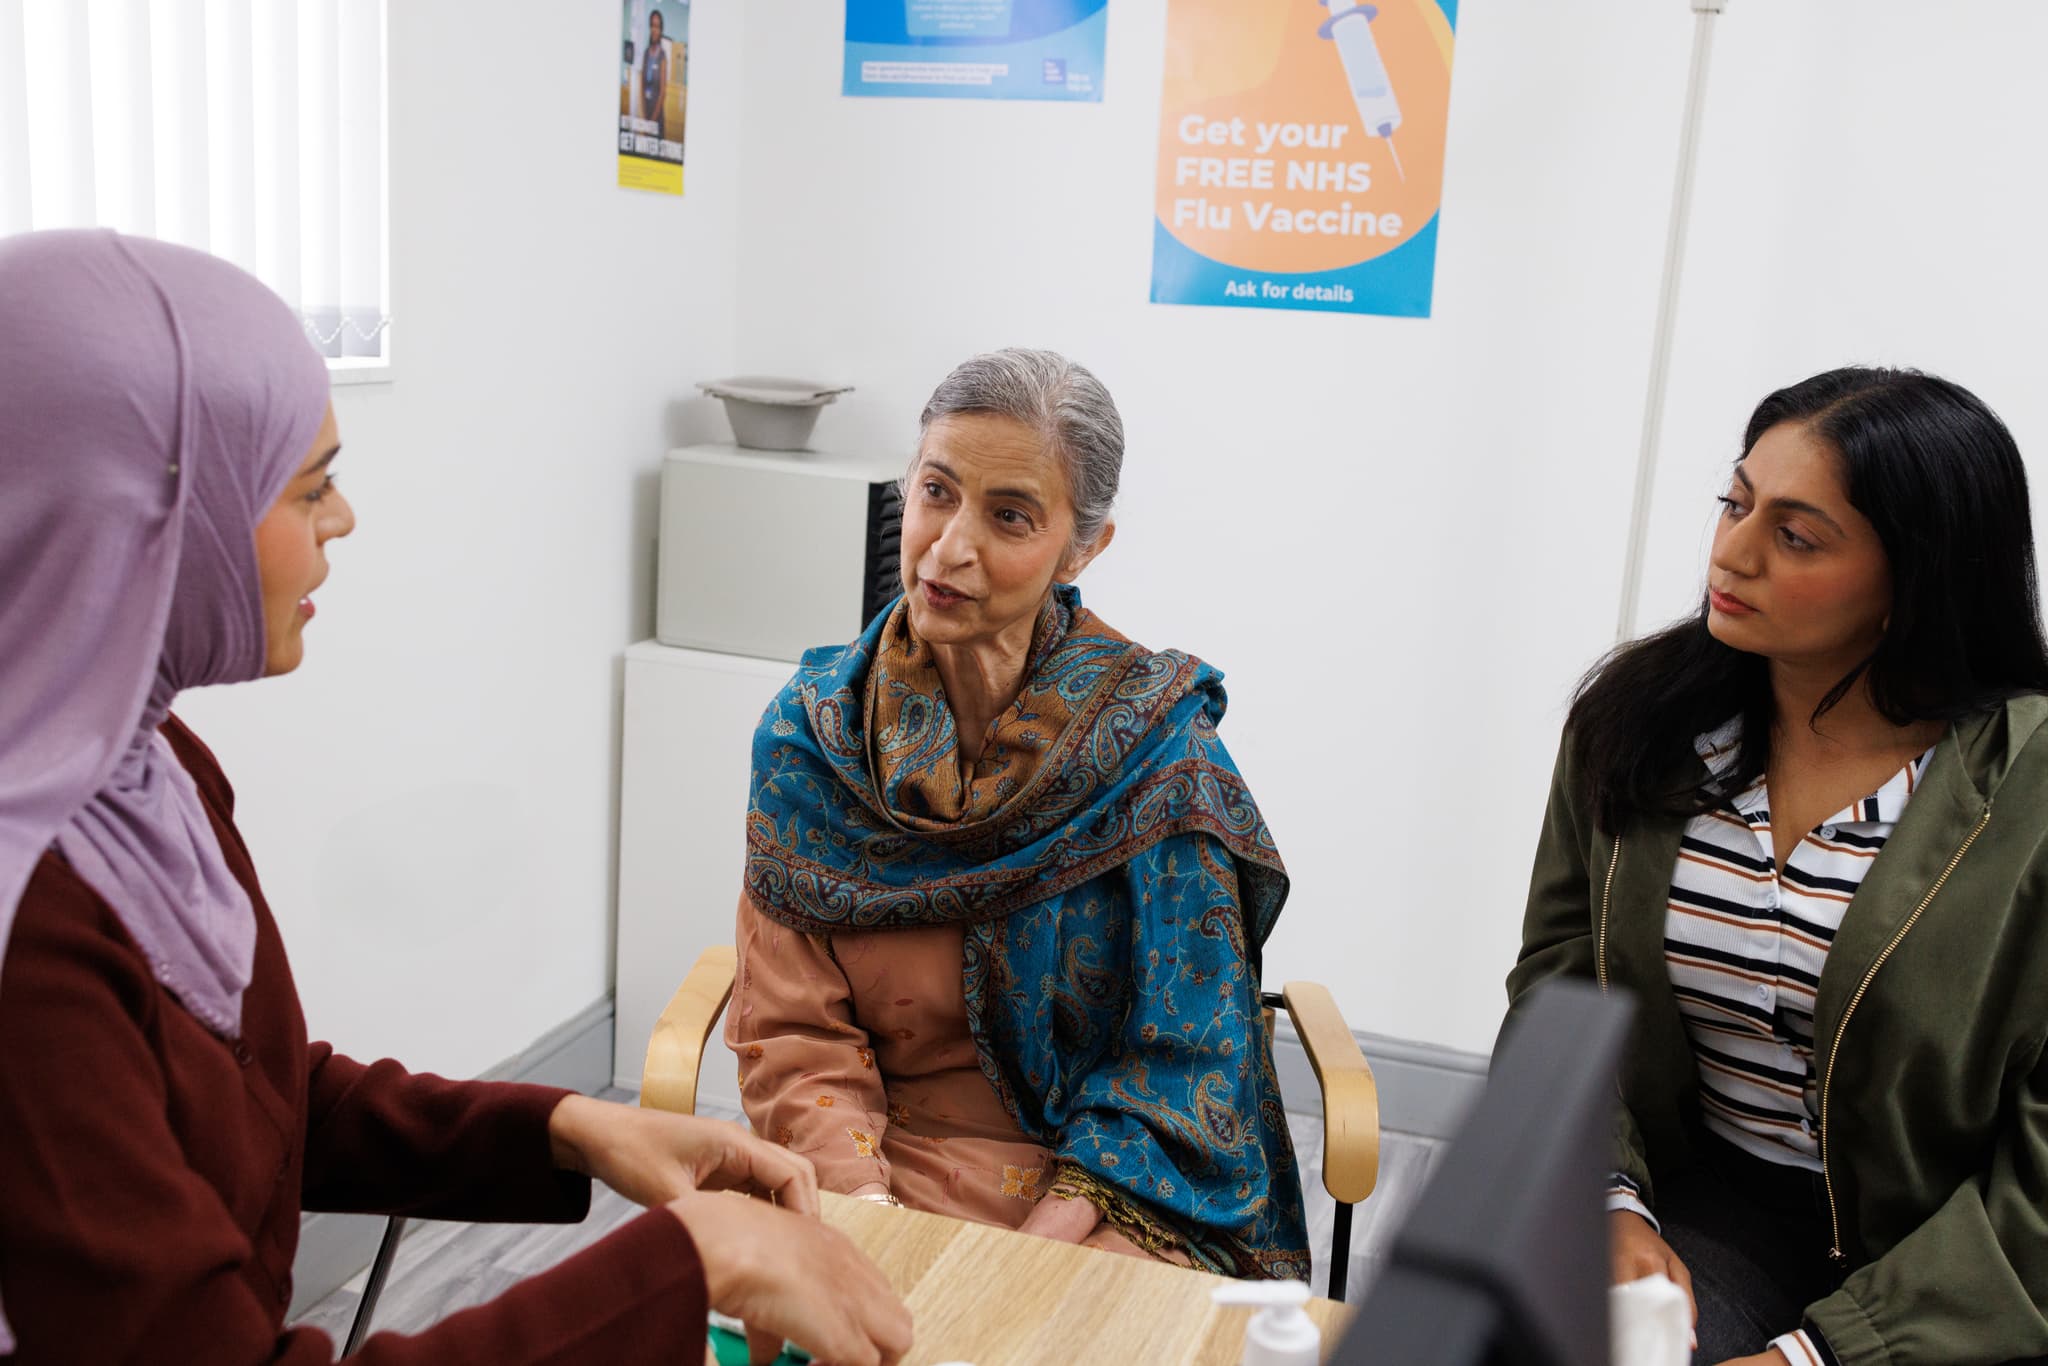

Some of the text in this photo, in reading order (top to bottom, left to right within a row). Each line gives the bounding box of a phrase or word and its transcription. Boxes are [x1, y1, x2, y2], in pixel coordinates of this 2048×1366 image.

[1178, 114, 1348, 153] Get your
[1176, 157, 1371, 193] FREE NHS
[1173, 198, 1403, 237] Flu Vaccine
[1225, 280, 1354, 303] Ask for details
